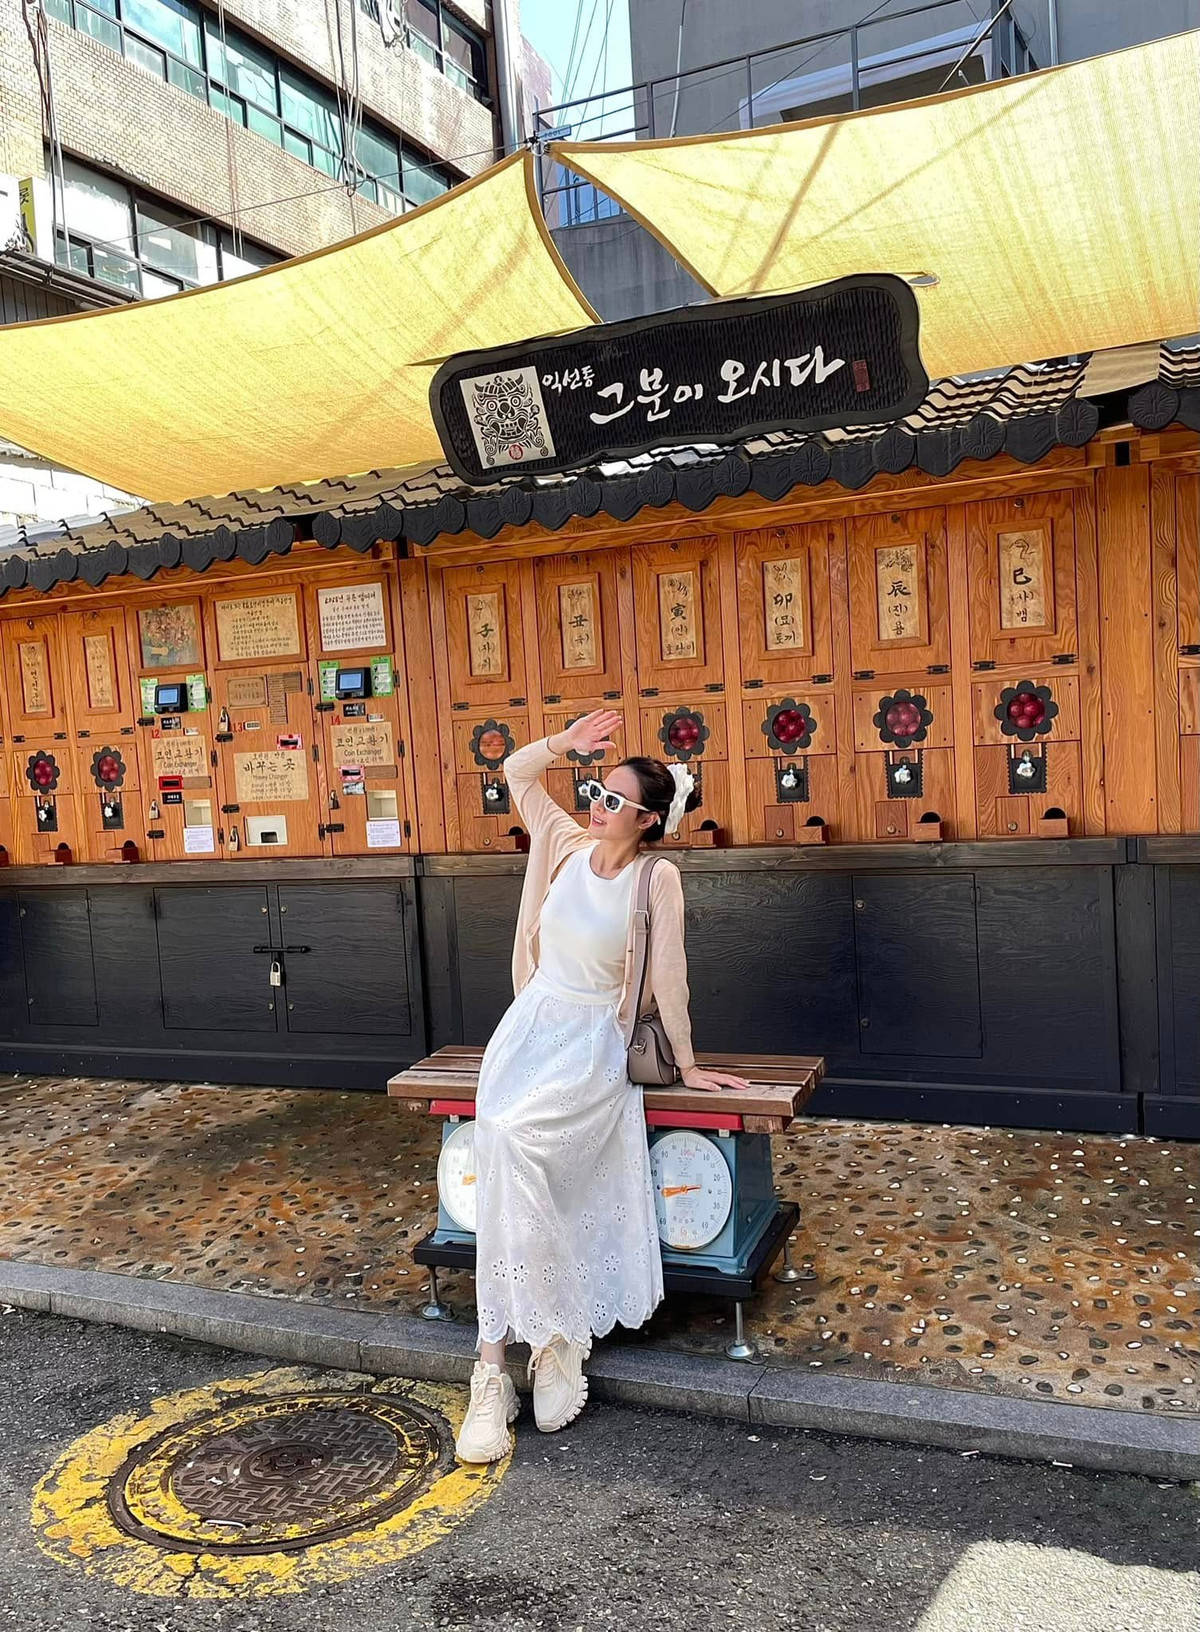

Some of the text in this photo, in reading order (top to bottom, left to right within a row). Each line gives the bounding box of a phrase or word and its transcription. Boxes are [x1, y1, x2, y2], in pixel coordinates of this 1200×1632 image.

[541, 364, 595, 396] 익선동
[590, 367, 704, 425] 그분이
[717, 345, 846, 403] 오시다
[887, 580, 912, 597] 辰
[773, 592, 793, 611] 卯
[670, 602, 686, 622] 寅
[888, 603, 908, 617] (진)
[1016, 608, 1028, 623] 뱀
[774, 615, 794, 627] (묘)
[476, 623, 494, 638] 子
[671, 624, 688, 636] (인)
[892, 621, 905, 636] 용
[774, 630, 796, 645] 토끼
[664, 640, 695, 656] 호랑이
[574, 651, 586, 661] 소
[331, 715, 341, 725] 14
[233, 722, 243, 733] 13
[151, 729, 161, 739] 12
[283, 758, 296, 771] 곳
[661, 1149, 669, 1159] 90
[703, 1152, 711, 1161] 10
[713, 1173, 722, 1182] 20
[713, 1201, 721, 1210] 30
[701, 1221, 709, 1229] 40
[680, 1229, 688, 1237] 50
